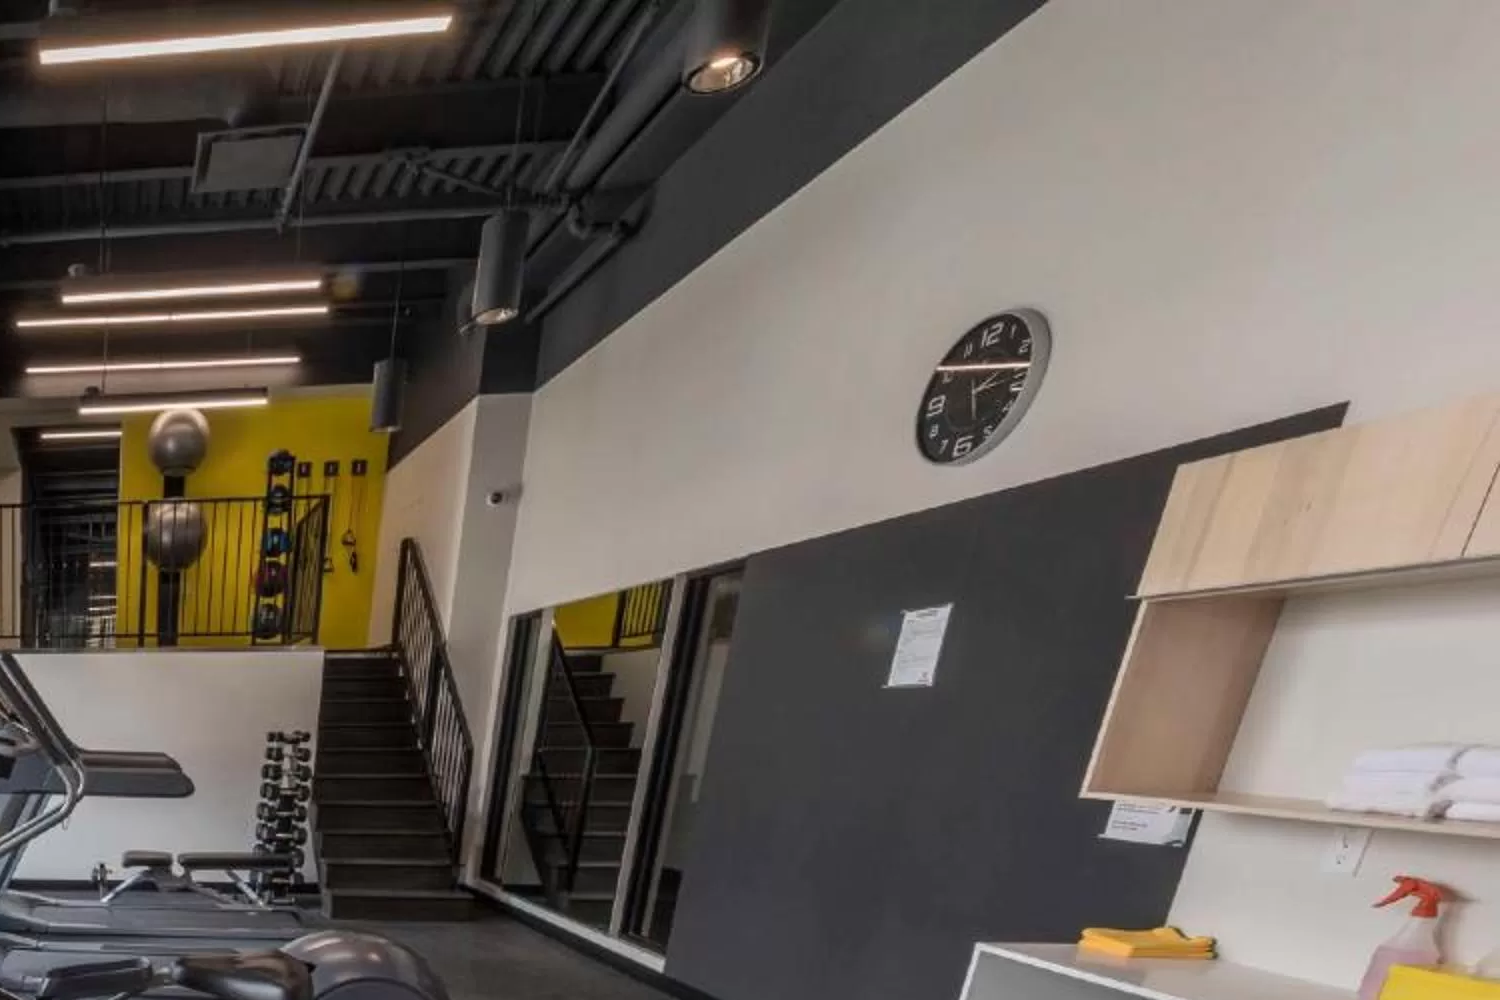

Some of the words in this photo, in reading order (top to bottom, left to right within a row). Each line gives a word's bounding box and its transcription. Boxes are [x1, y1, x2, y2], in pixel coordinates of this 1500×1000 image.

[980, 322, 1004, 349] 12
[1011, 324, 1017, 339] 1
[1018, 339, 1032, 354] 2
[926, 394, 946, 418] 9
[930, 423, 940, 438] 8
[939, 439, 949, 454] 7
[953, 434, 975, 457] 6
